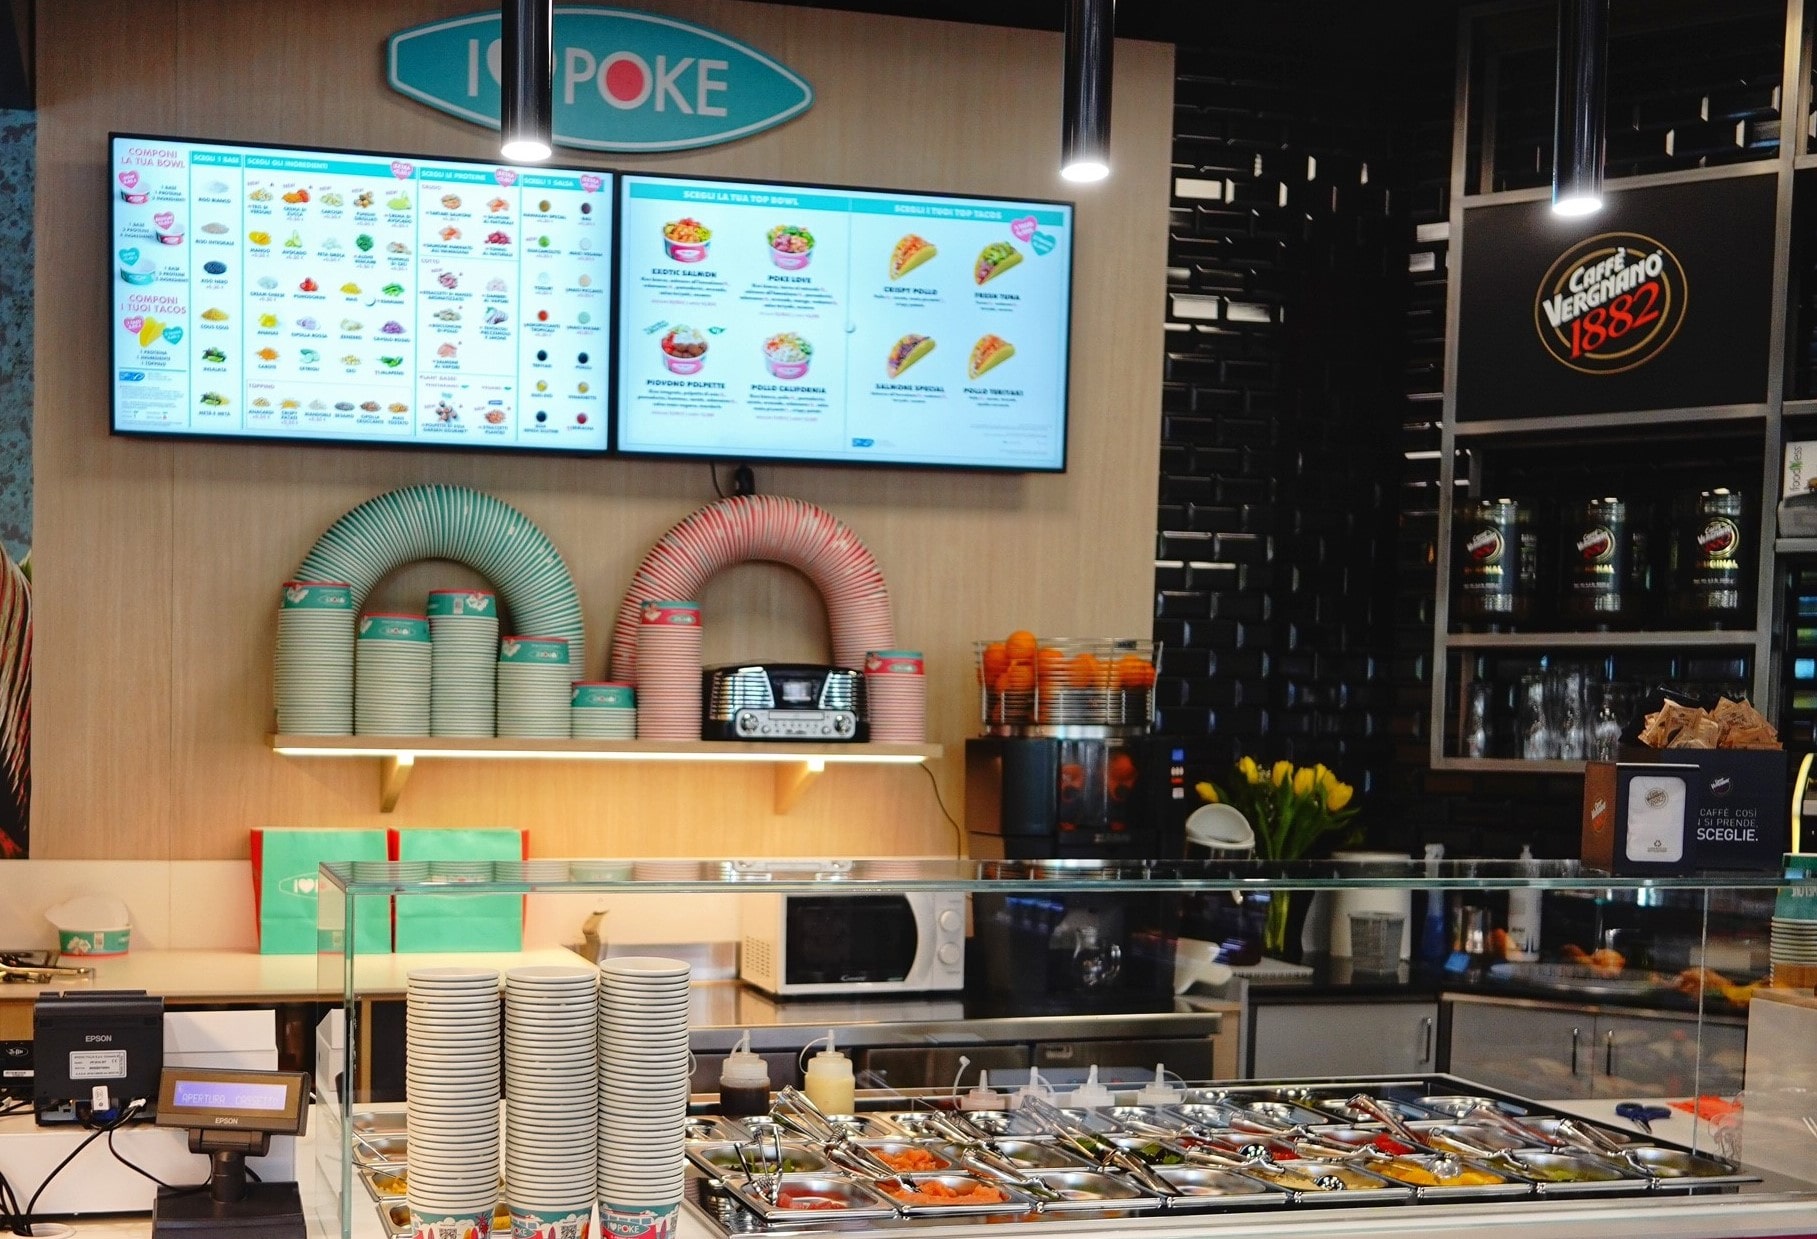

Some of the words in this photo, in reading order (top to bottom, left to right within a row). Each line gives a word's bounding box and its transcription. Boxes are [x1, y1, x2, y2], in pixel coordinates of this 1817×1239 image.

[468, 38, 479, 96] I
[564, 47, 729, 117] POKE
[128, 148, 178, 158] COMPONI
[136, 158, 154, 166] TUA
[157, 159, 186, 168] BOWL
[683, 190, 716, 200] SCEGLI
[717, 192, 729, 201] LA
[730, 193, 750, 202] TUA
[751, 194, 770, 204] TOP
[771, 196, 798, 206] BOWL
[895, 204, 926, 214] SCEGLI
[956, 208, 973, 217] TOP
[975, 210, 1002, 220] TACOS
[652, 268, 680, 276] EXOTIC
[682, 270, 717, 278] SALMON
[768, 274, 788, 282] POKE
[1542, 250, 1663, 328] VERGNANO
[129, 294, 178, 304] COMPONI
[127, 304, 151, 312] TUOI
[154, 304, 187, 314] TACOS
[1570, 281, 1660, 359] 1882
[646, 379, 684, 387] PIOVONO
[687, 380, 726, 389] POLPETTE
[752, 384, 777, 392] POLLO
[779, 384, 826, 394] CALIFORNIA
[1700, 807, 1729, 817] CAFFÈ
[1735, 807, 1757, 817] COSÌ
[1704, 818, 1713, 826] SI
[1716, 818, 1759, 828] PRENDE,
[1697, 827, 1759, 842] SCEGLIE.
[85, 1034, 112, 1043] EPSON
[182, 1092, 226, 1104] APERTURA
[215, 1117, 238, 1125] EPSON
[617, 1224, 640, 1233] POKE
